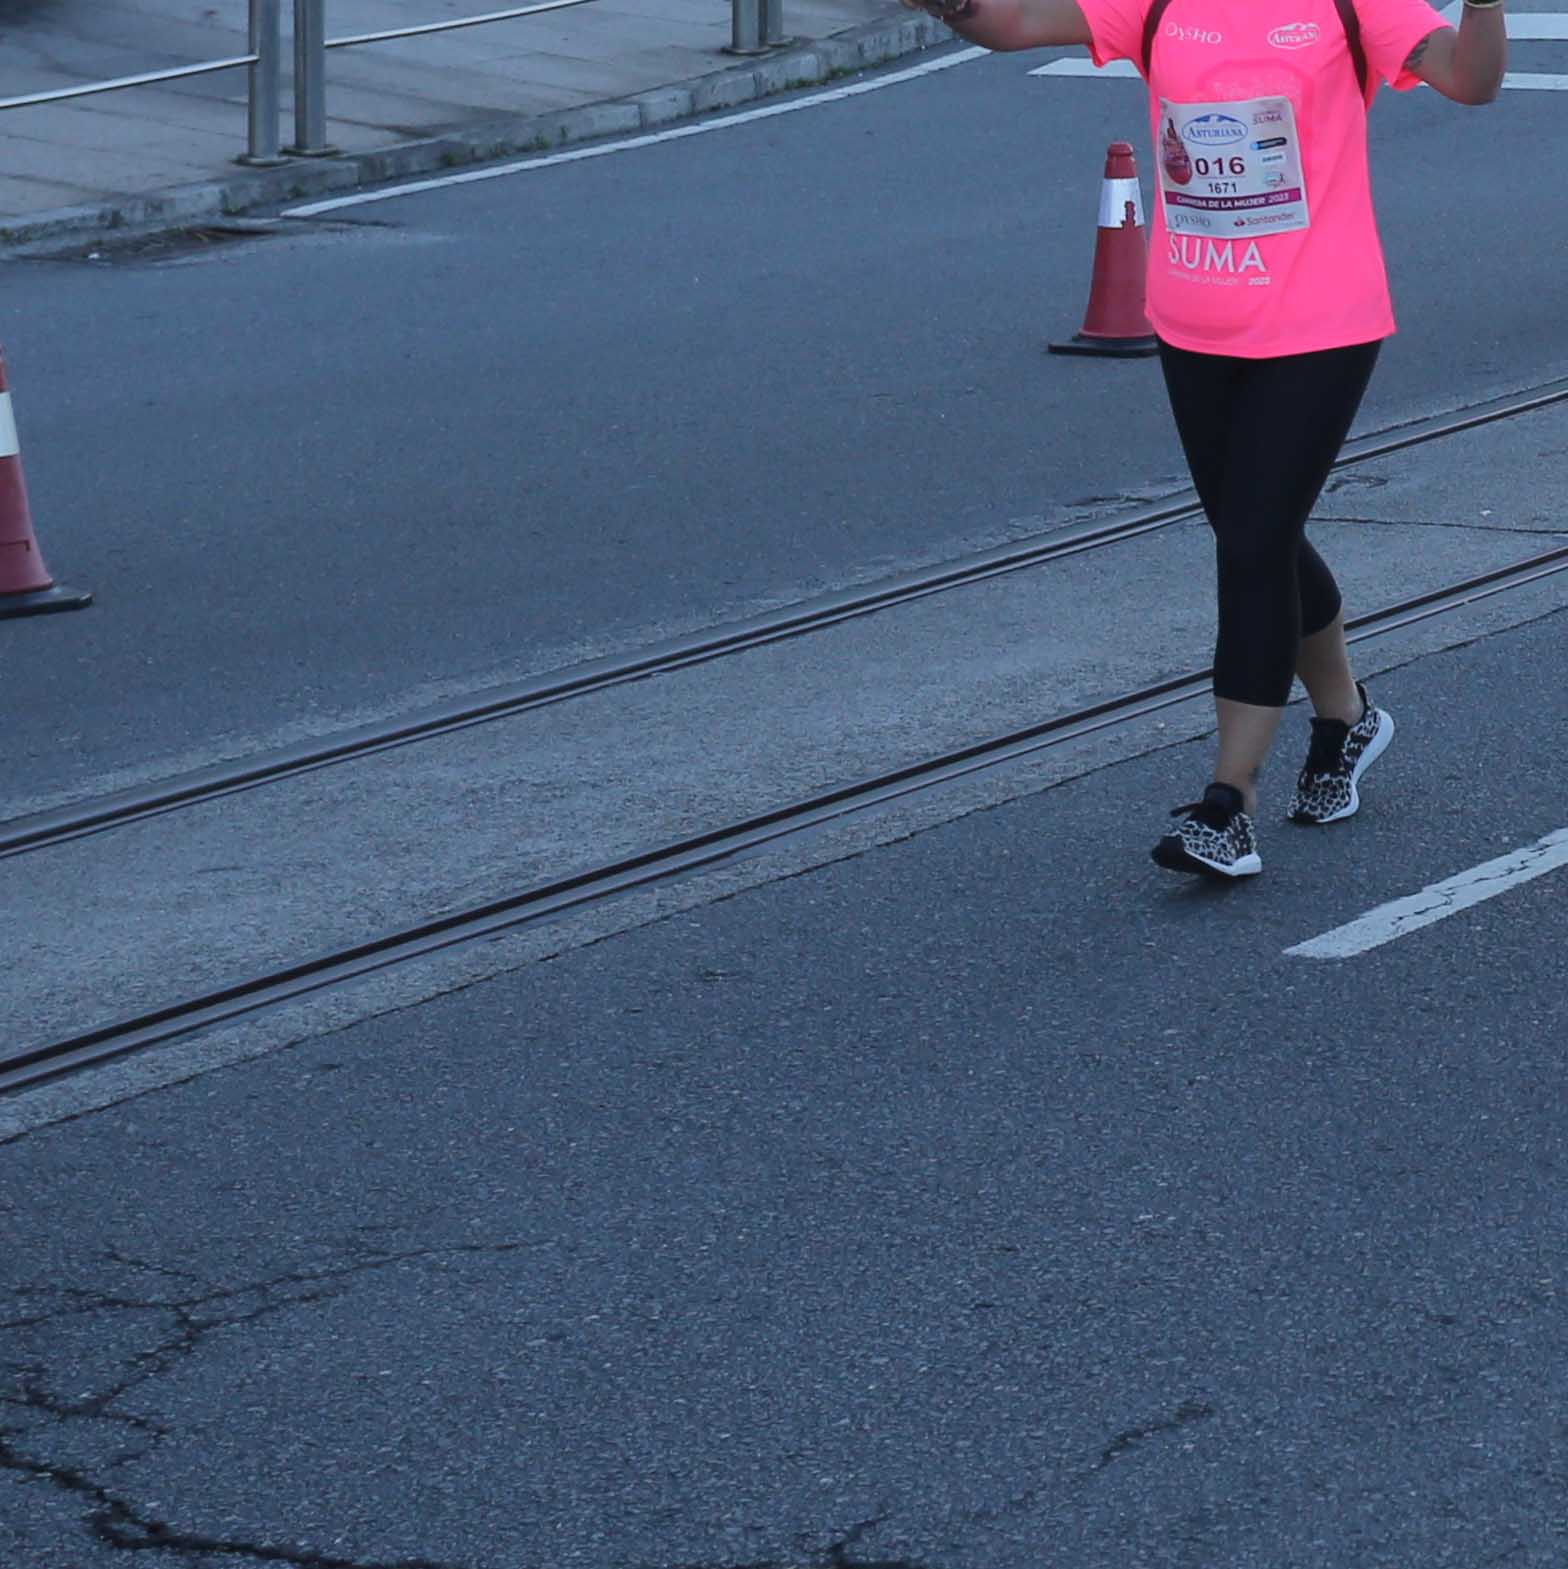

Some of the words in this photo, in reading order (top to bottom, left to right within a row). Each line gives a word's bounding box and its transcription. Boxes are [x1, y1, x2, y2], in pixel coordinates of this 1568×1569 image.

[1166, 21, 1222, 45] OYSHO
[1188, 125, 1244, 139] ASTURIANA
[1194, 156, 1246, 176] 016
[1207, 182, 1238, 194] 1671
[1208, 201, 1219, 209] DE
[1220, 201, 1233, 209] LA
[1247, 212, 1296, 225] Santander
[1168, 234, 1268, 273] SUMA
